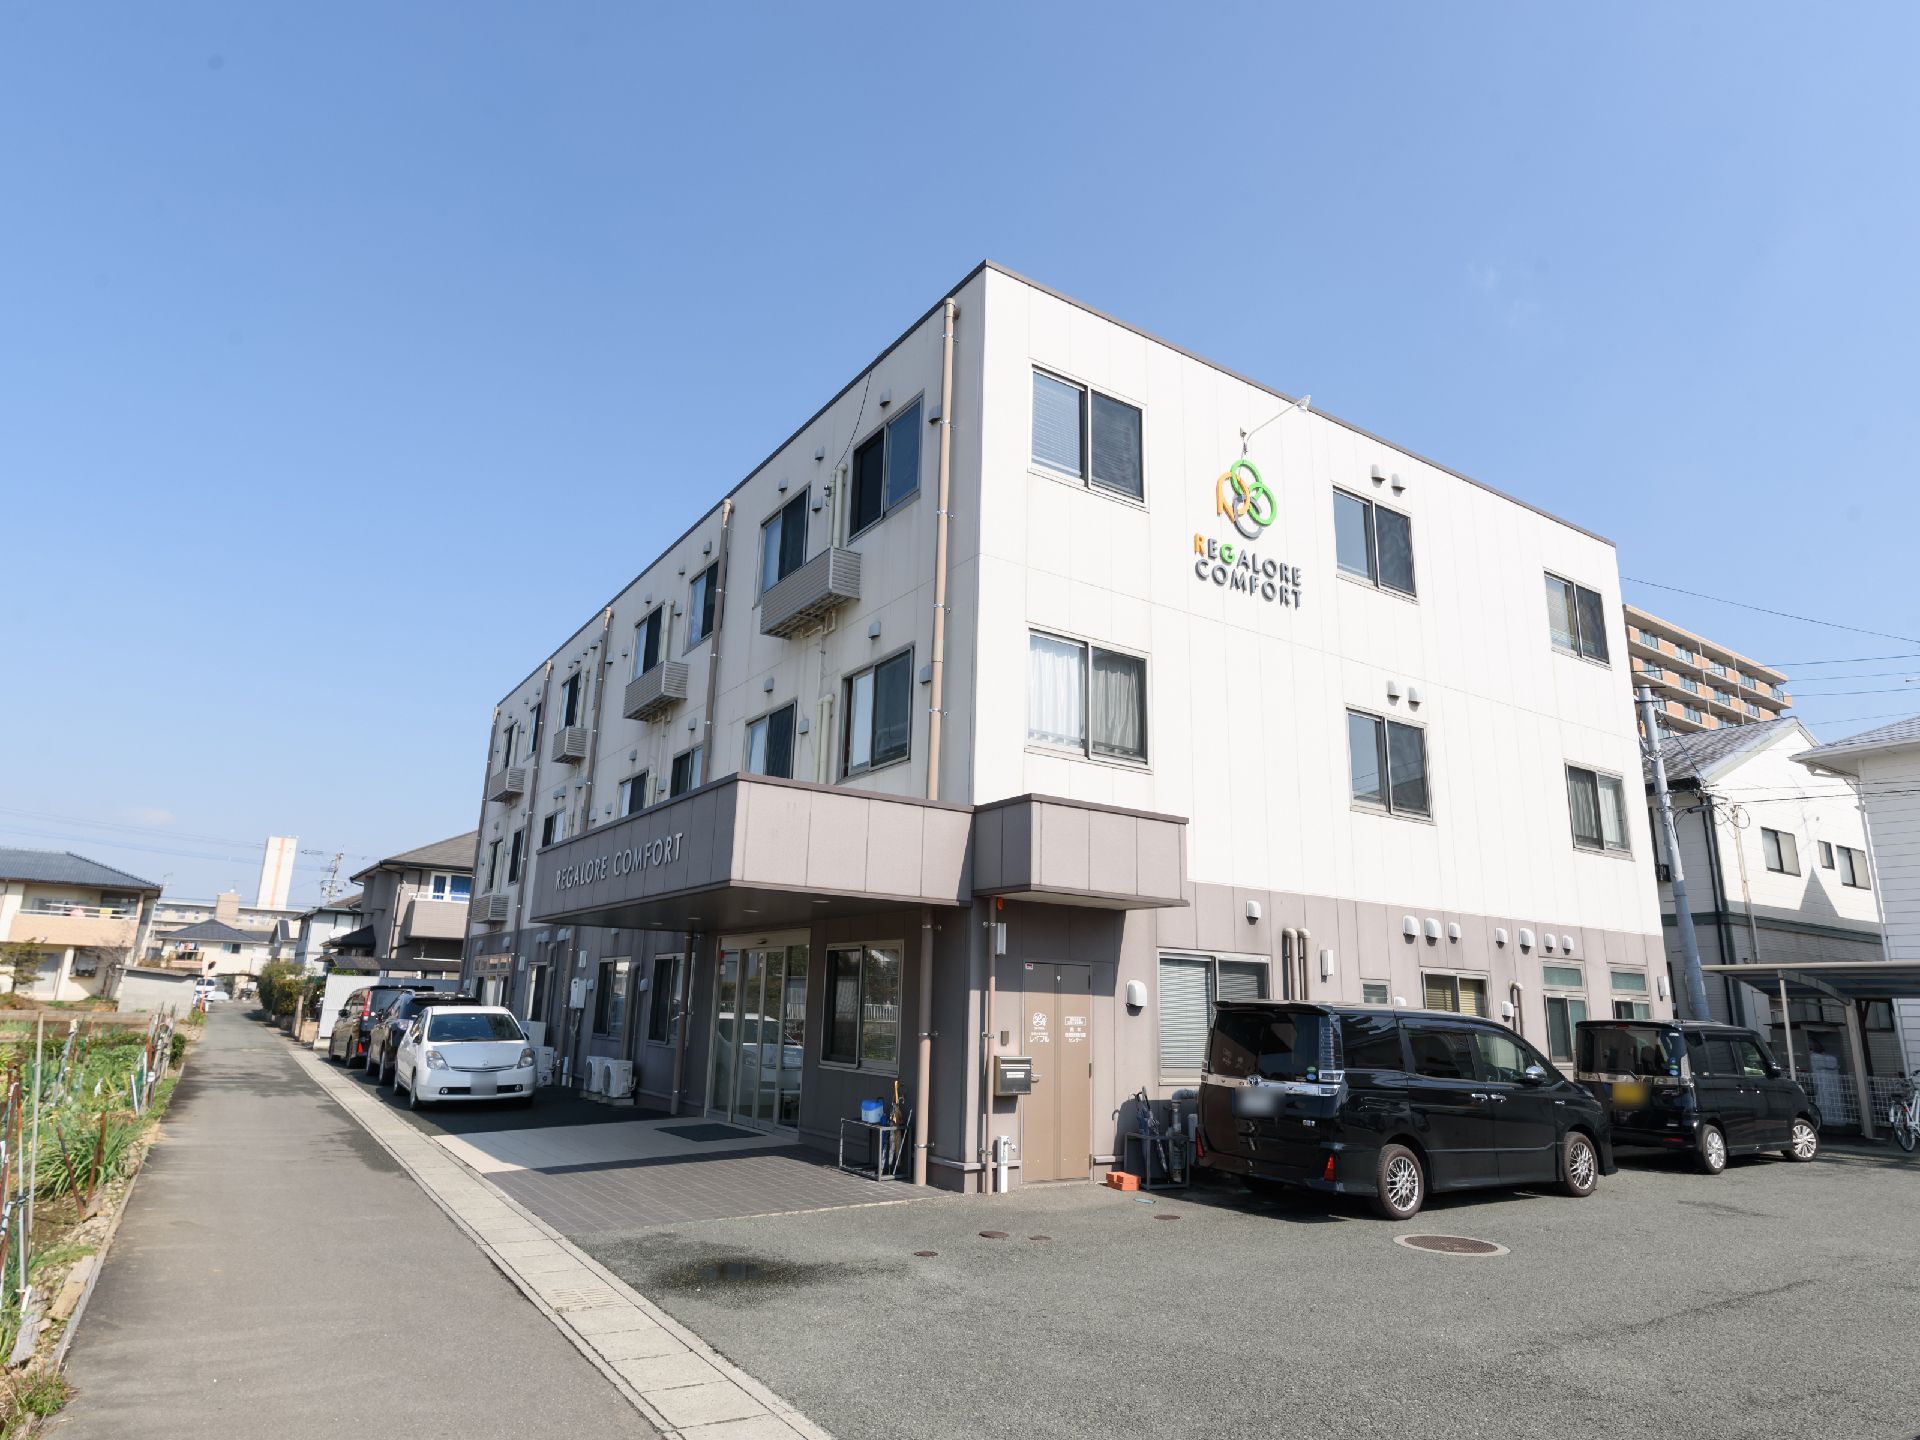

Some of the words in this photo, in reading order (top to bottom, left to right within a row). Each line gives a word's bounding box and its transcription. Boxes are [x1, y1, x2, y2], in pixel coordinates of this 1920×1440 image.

[1194, 533, 1301, 587] REGALORE
[1195, 559, 1302, 611] COMFORT
[555, 856, 608, 891] REGALORE
[613, 832, 683, 876] COMFORT
